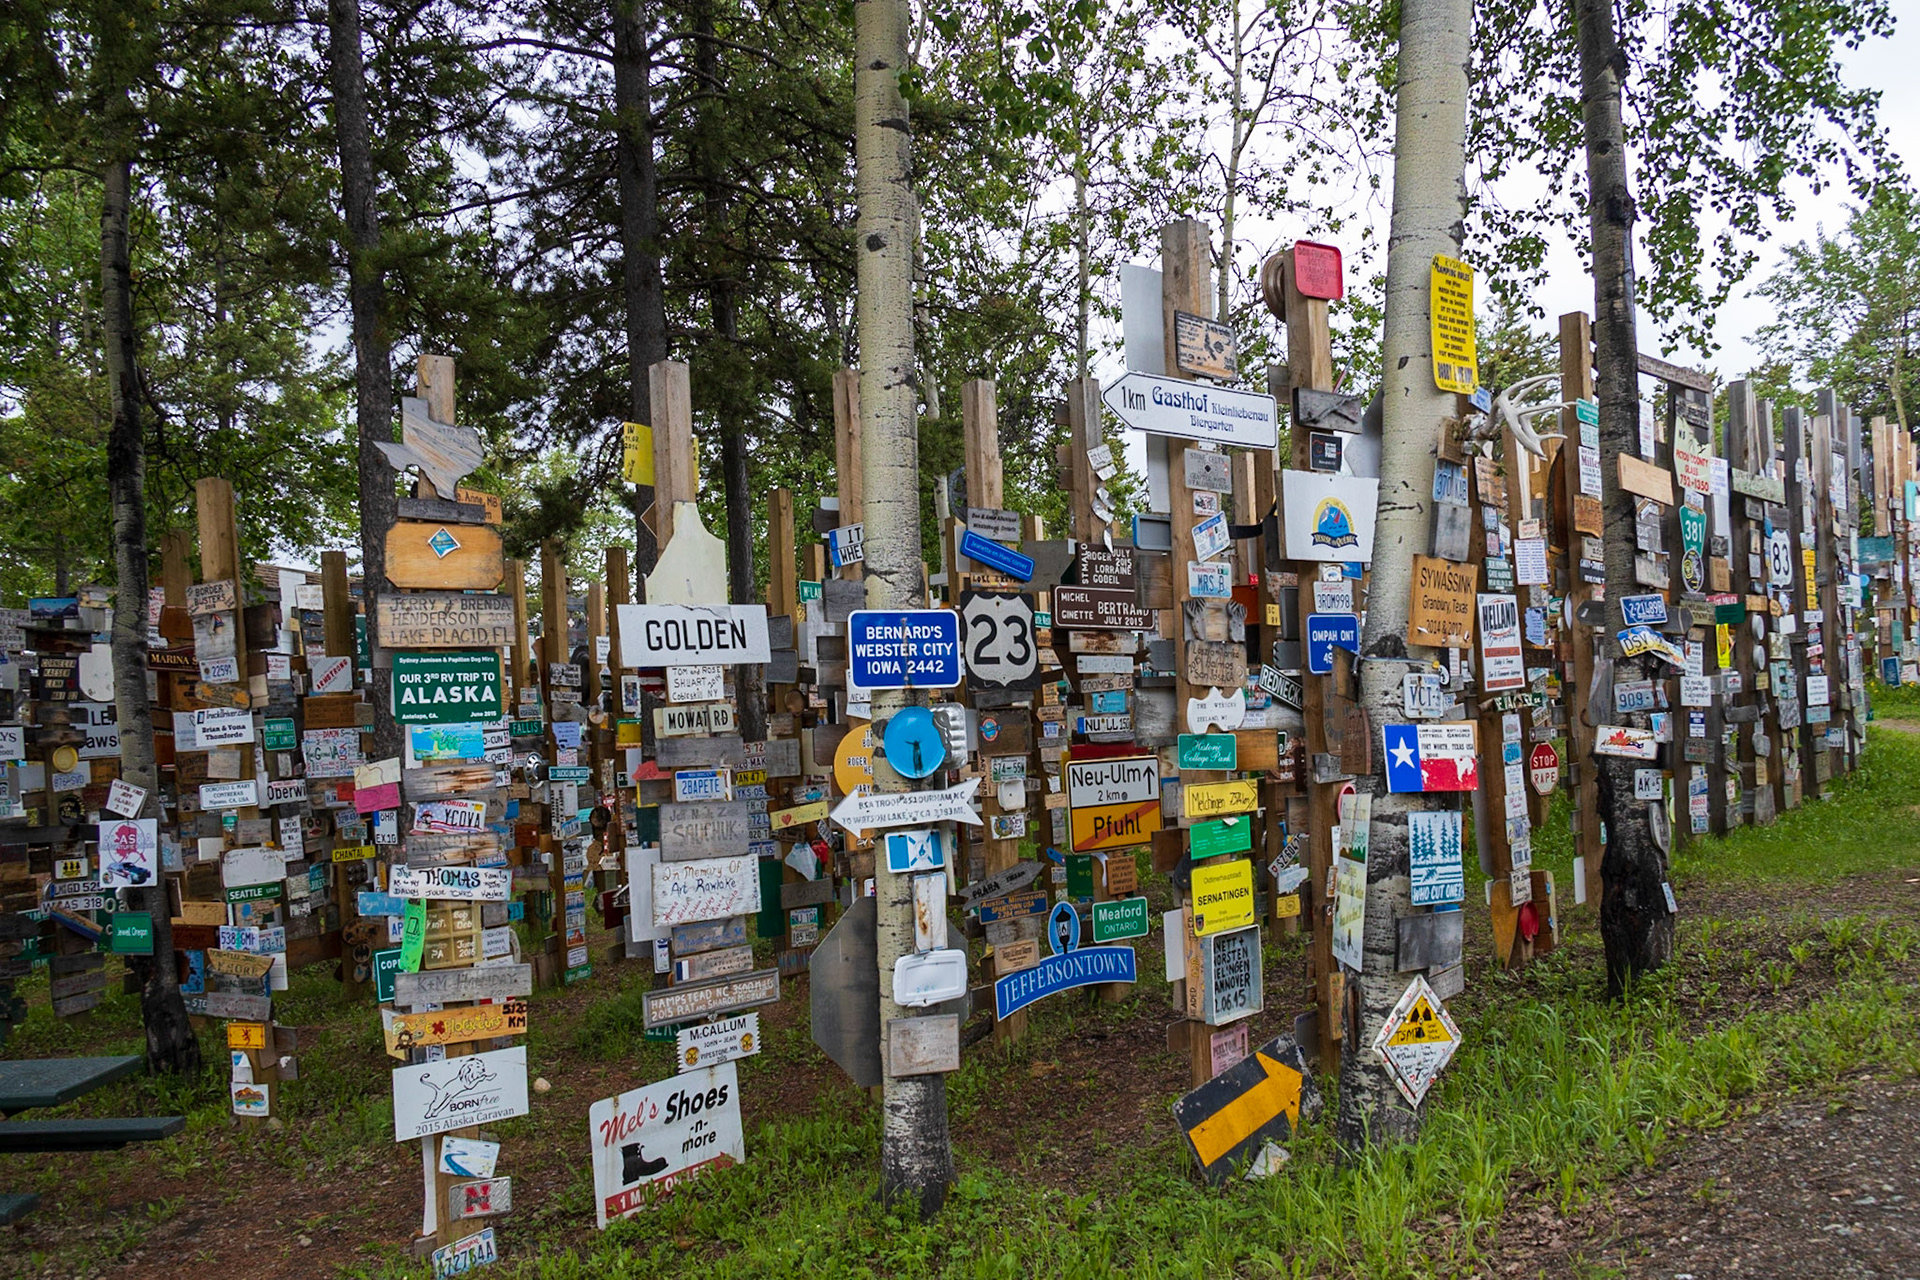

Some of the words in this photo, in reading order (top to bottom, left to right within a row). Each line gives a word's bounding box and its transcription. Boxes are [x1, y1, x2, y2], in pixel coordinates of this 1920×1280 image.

[1152, 386, 1208, 412] Gasthof
[1212, 402, 1268, 422] Kleinliebenau
[1190, 414, 1234, 432] Biergarten
[1680, 474, 1710, 492] 752-1350
[1684, 520, 1702, 542] 381
[1088, 551, 1112, 562] ROGER
[1116, 558, 1132, 566] 2015
[1772, 542, 1790, 575] 83
[1094, 564, 1132, 576] LORRAINE
[1092, 574, 1120, 584] GOBEIL
[1420, 567, 1474, 594] SYWASSINK
[195, 584, 223, 596] BORDER
[1060, 592, 1090, 602] MICHEL
[194, 593, 226, 605] BUSTERS
[390, 598, 436, 612] JERRY
[460, 598, 511, 610] BRENDA
[1452, 598, 1468, 614] Texas
[392, 611, 479, 626] HENDERSON
[1062, 610, 1094, 620] GINETTE
[1104, 616, 1122, 624] JULY
[1124, 616, 1144, 626] 2015
[1482, 602, 1516, 632] HELLAND
[390, 629, 429, 645] LAKE
[432, 628, 490, 646] PLACID,
[492, 626, 512, 644] FL
[646, 619, 747, 651] GOLDEN
[866, 626, 942, 640] BERNARD'S
[970, 613, 1032, 666] 23
[1312, 630, 1338, 642] OMPAH
[1340, 630, 1354, 642] ONT
[856, 643, 918, 658] WEBSTER
[923, 642, 954, 656] CITY
[152, 653, 191, 666] MARINA
[867, 660, 902, 674] IOWA
[907, 660, 945, 674] 2442
[316, 658, 348, 690] ARMSTRONG
[400, 673, 422, 684] OUR
[424, 672, 440, 684] 3RD
[440, 672, 454, 682] RV
[456, 672, 480, 682] TRIP
[482, 672, 495, 682] TO
[672, 668, 688, 676] TOM
[702, 666, 720, 674] ROSE
[400, 686, 496, 704] ALASKA
[668, 710, 708, 729] MOWAT
[714, 710, 728, 726] RD
[512, 722, 539, 734] FALLIS
[848, 758, 868, 766] ROGER
[1183, 750, 1209, 767] College
[1532, 756, 1556, 768] STOP
[1072, 762, 1141, 788] Neu-Ulm
[1534, 772, 1556, 784] RAPE
[876, 796, 902, 808] TROOP
[1098, 791, 1104, 801] 2
[1106, 789, 1120, 800] km
[852, 814, 886, 824] WATSON
[1094, 812, 1141, 838] Pfuhl
[334, 850, 366, 861] CHANTAL
[684, 865, 722, 880] Memory
[728, 860, 742, 874] Of
[418, 868, 480, 889] THOMAS
[229, 888, 263, 900] SEATTLE
[670, 882, 688, 897] Art
[972, 882, 1000, 899] PRAHA
[1197, 886, 1250, 906] SERNATINGEN
[1412, 886, 1427, 900] WHO
[1429, 885, 1444, 898] CUT
[1446, 884, 1462, 898] ONE?
[1098, 905, 1142, 922] Meaford
[1104, 922, 1138, 935] ONTARIO
[431, 950, 444, 959] PA
[1004, 953, 1128, 1012] JEFFERSONTOWN
[651, 988, 712, 1010] HAMPSTEAD
[716, 986, 729, 997] NC
[502, 1002, 528, 1015] 5120
[652, 1009, 673, 1022] 2015
[708, 995, 736, 1009] SHARON
[508, 1016, 526, 1028] KM
[704, 1039, 718, 1048] JOHN
[450, 1100, 479, 1112] BORN
[416, 1122, 441, 1136] 2015
[443, 1115, 475, 1130] Alaska
[476, 1107, 515, 1122] Caravan
[600, 1096, 660, 1148] Mel's
[664, 1084, 728, 1125] Shoes
[682, 1130, 716, 1154] more
